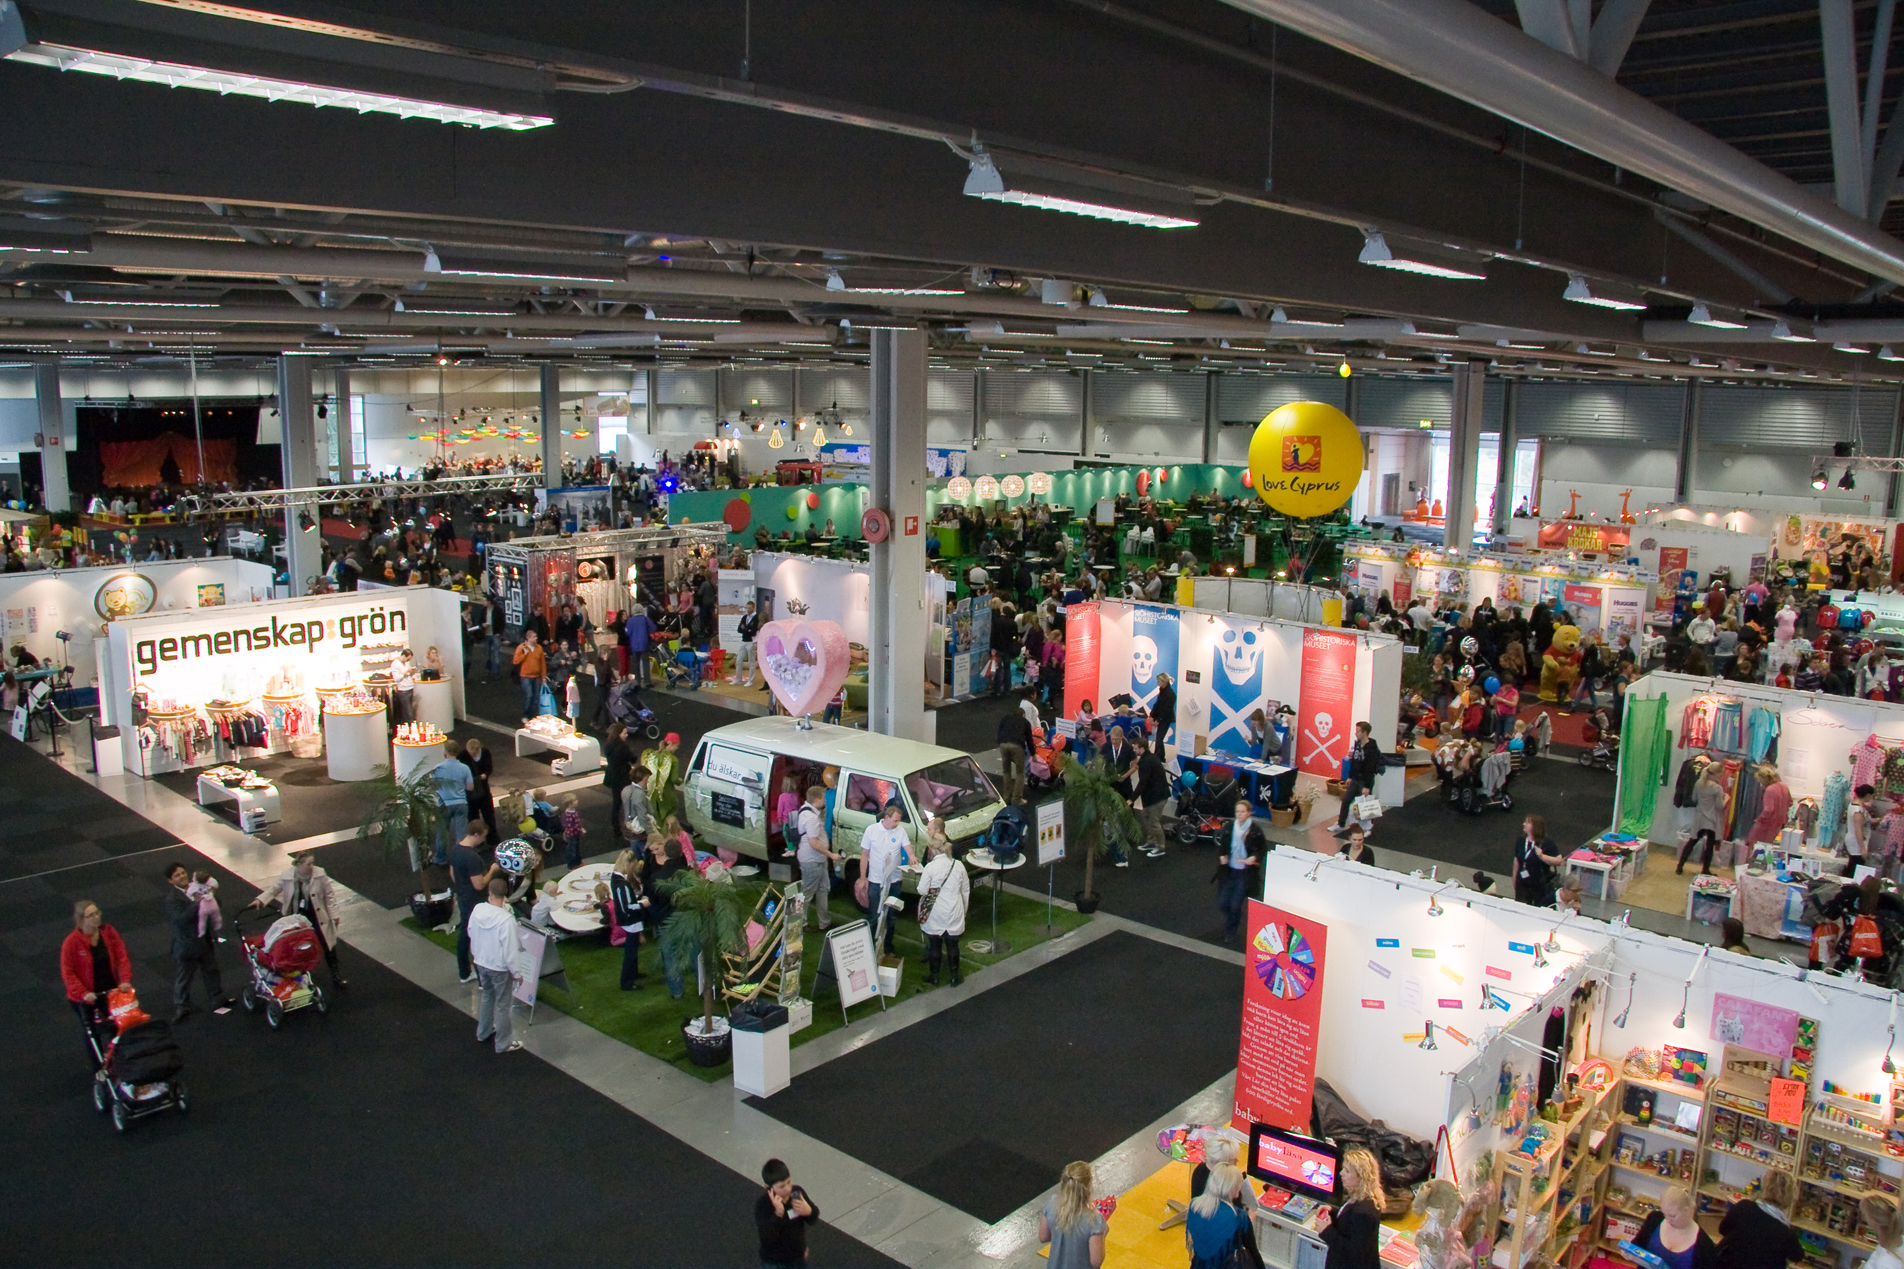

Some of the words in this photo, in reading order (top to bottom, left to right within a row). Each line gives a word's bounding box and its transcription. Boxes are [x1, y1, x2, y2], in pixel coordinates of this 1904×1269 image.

[1262, 474, 1287, 492] Love
[1290, 476, 1340, 495] Cyprus
[1567, 537, 1603, 550] KROKAR
[1067, 604, 1098, 616] SJÖHISTORISK
[1302, 640, 1331, 650] MUSEET
